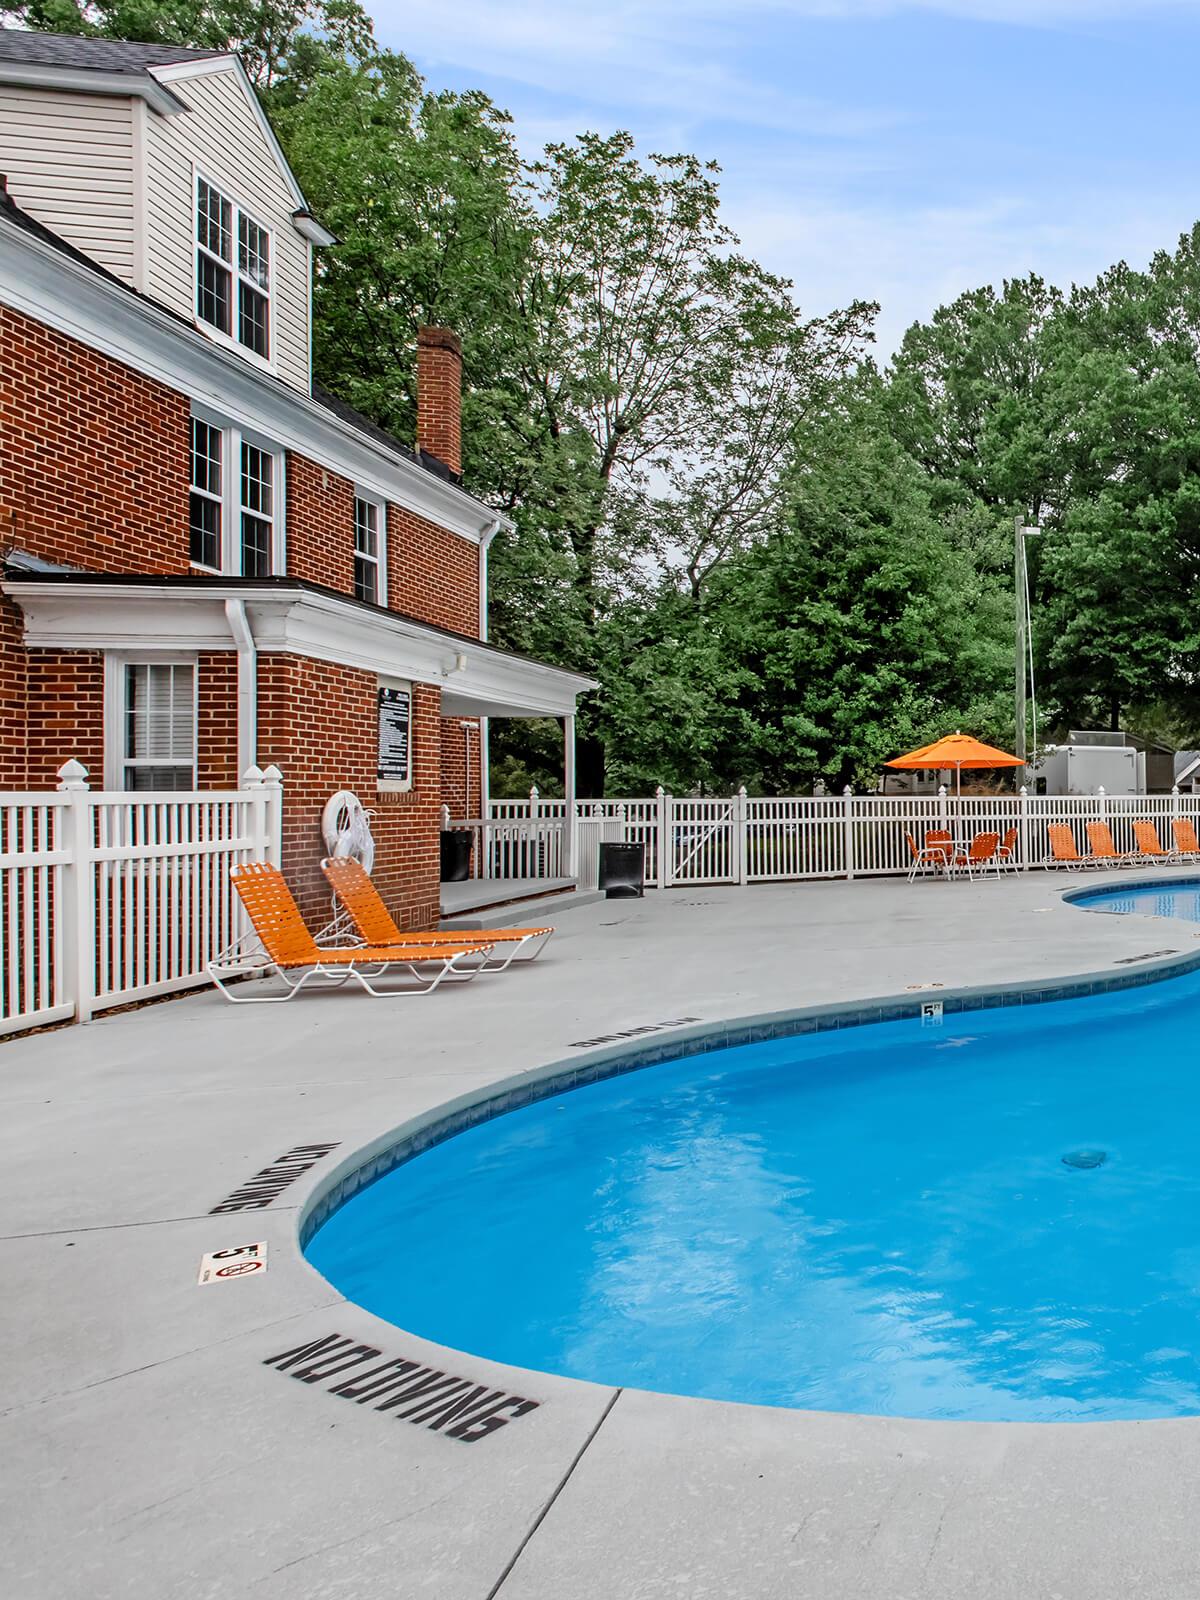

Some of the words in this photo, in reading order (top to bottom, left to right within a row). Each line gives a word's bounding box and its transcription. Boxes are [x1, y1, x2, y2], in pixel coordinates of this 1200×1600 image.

[923, 1005, 934, 1017] 5
[272, 1141, 344, 1164] NO
[208, 1161, 317, 1215] DIVING
[212, 1244, 258, 1259] 5
[262, 1333, 383, 1384] NO
[327, 1357, 541, 1443] DIVING
